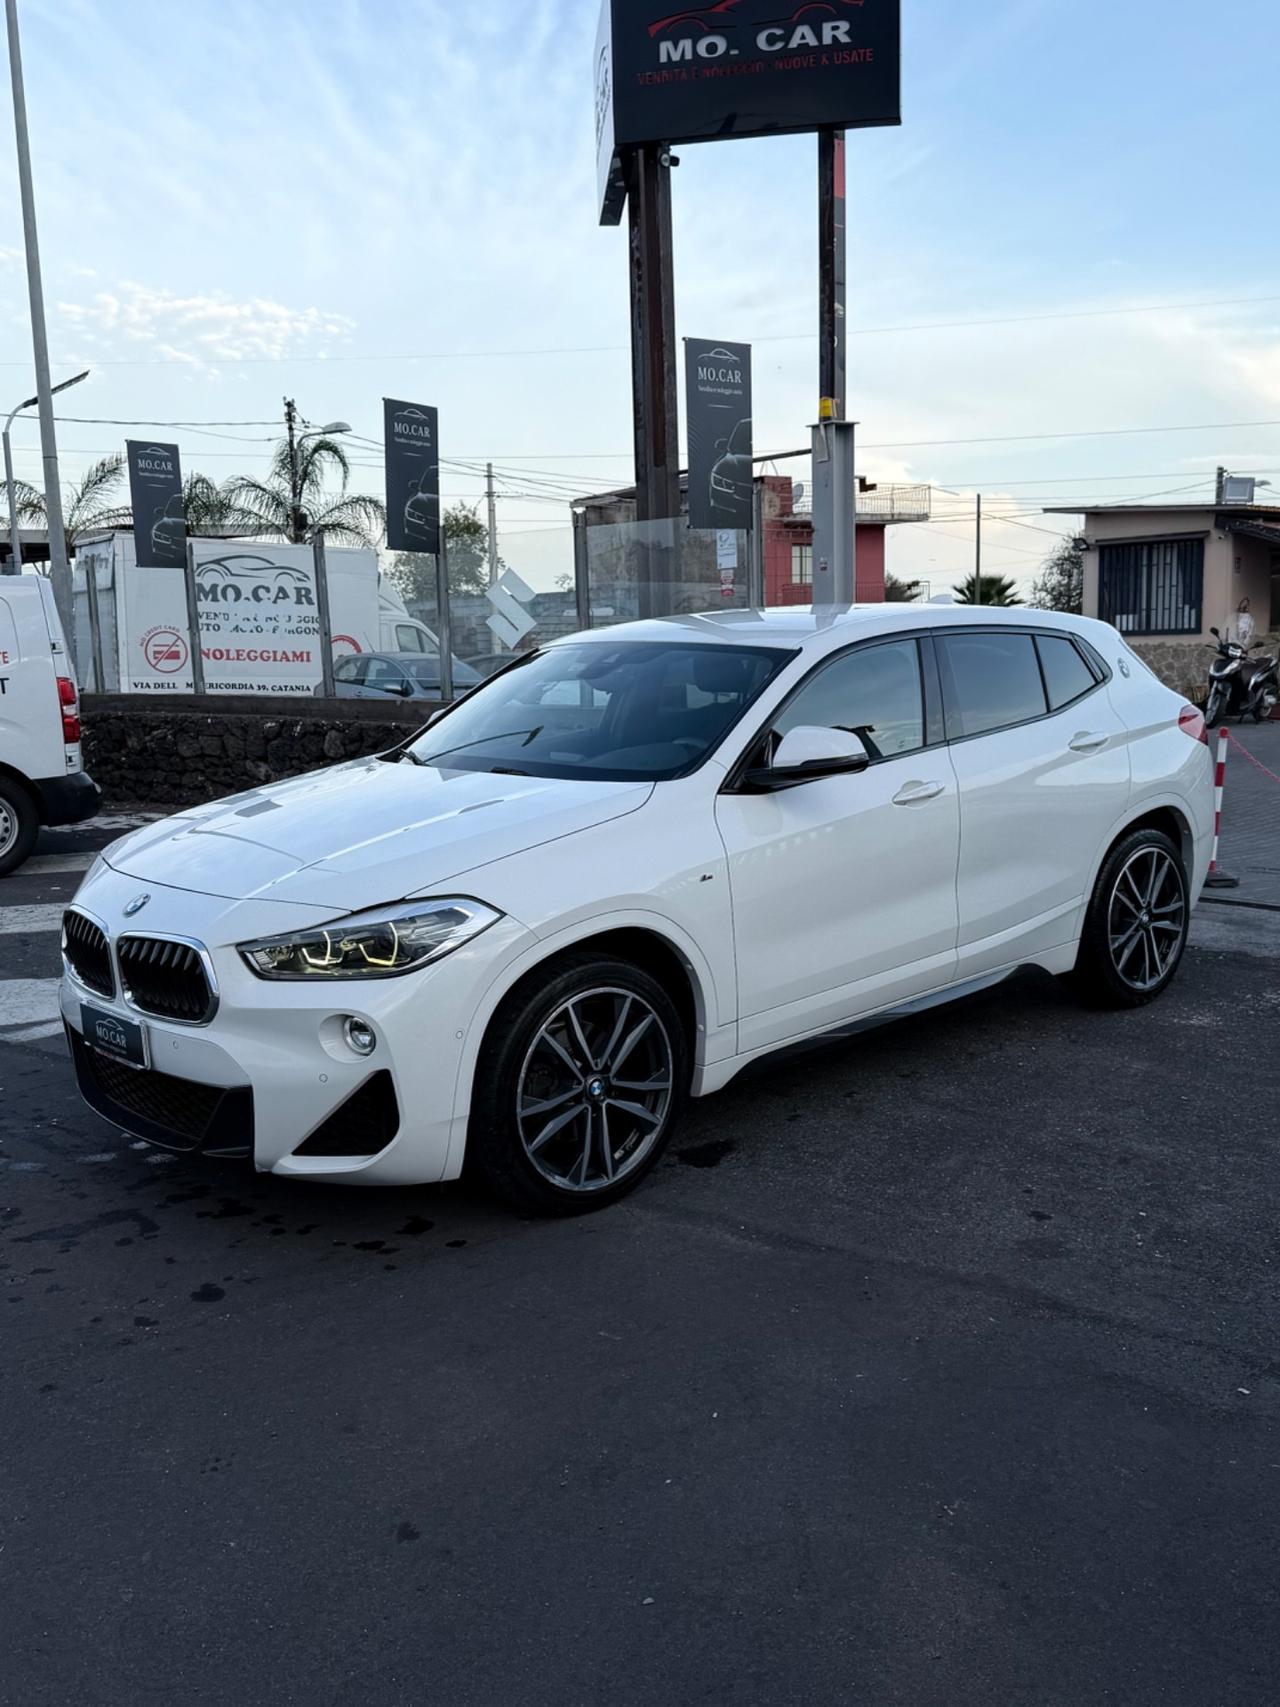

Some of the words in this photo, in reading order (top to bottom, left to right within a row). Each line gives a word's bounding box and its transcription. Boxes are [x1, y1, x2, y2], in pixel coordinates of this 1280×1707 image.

[659, 35, 740, 64] MO.
[756, 20, 852, 51] CAR
[774, 55, 817, 70] NUOVE
[833, 48, 874, 65] USATE
[697, 366, 742, 384] MO.CAR
[393, 421, 431, 438] MO.CAR
[137, 459, 173, 472] MO.CAR
[197, 583, 315, 606] MO.CAR
[200, 648, 312, 663] NOLEGGIAMI
[271, 684, 312, 693] CATANIA
